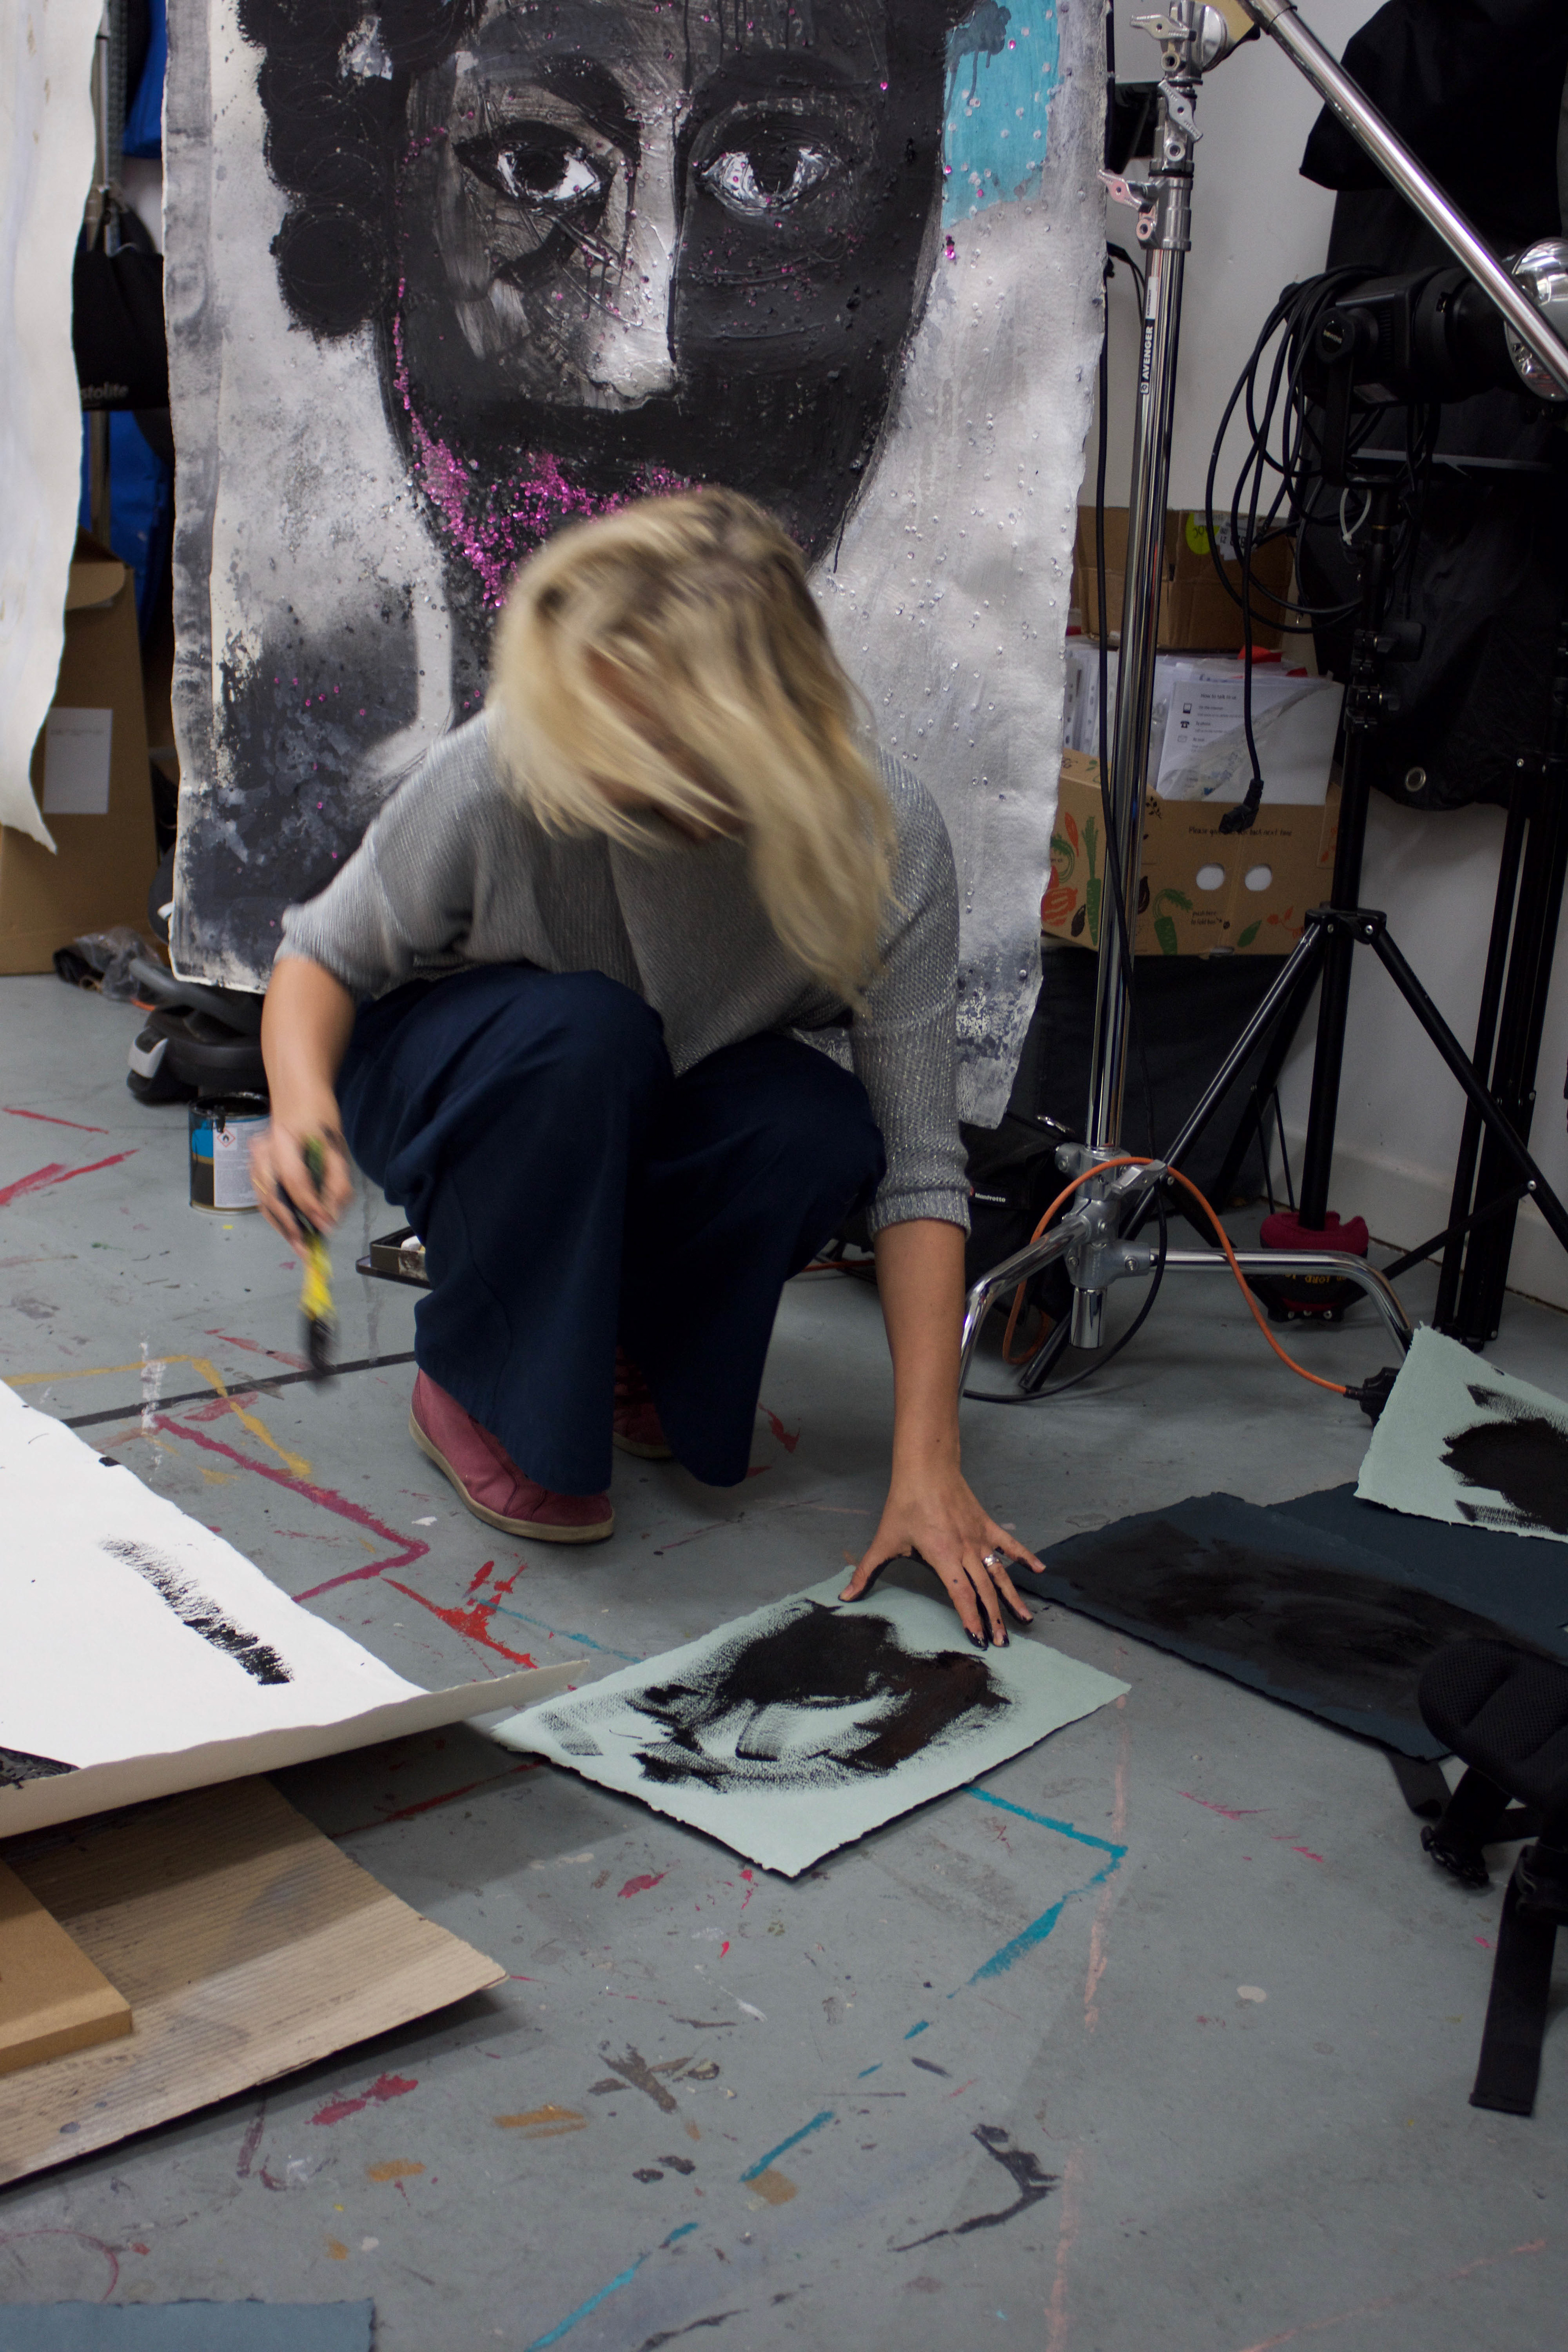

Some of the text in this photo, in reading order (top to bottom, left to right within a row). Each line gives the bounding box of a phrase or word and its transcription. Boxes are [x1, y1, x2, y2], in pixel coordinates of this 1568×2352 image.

[1142, 326, 1153, 380] AVENGER
[82, 381, 129, 400] stolite
[1189, 826, 1207, 834] Please
[1263, 828, 1277, 836] next
[1280, 828, 1292, 836] time
[975, 1192, 1006, 1203] Manfrotto
